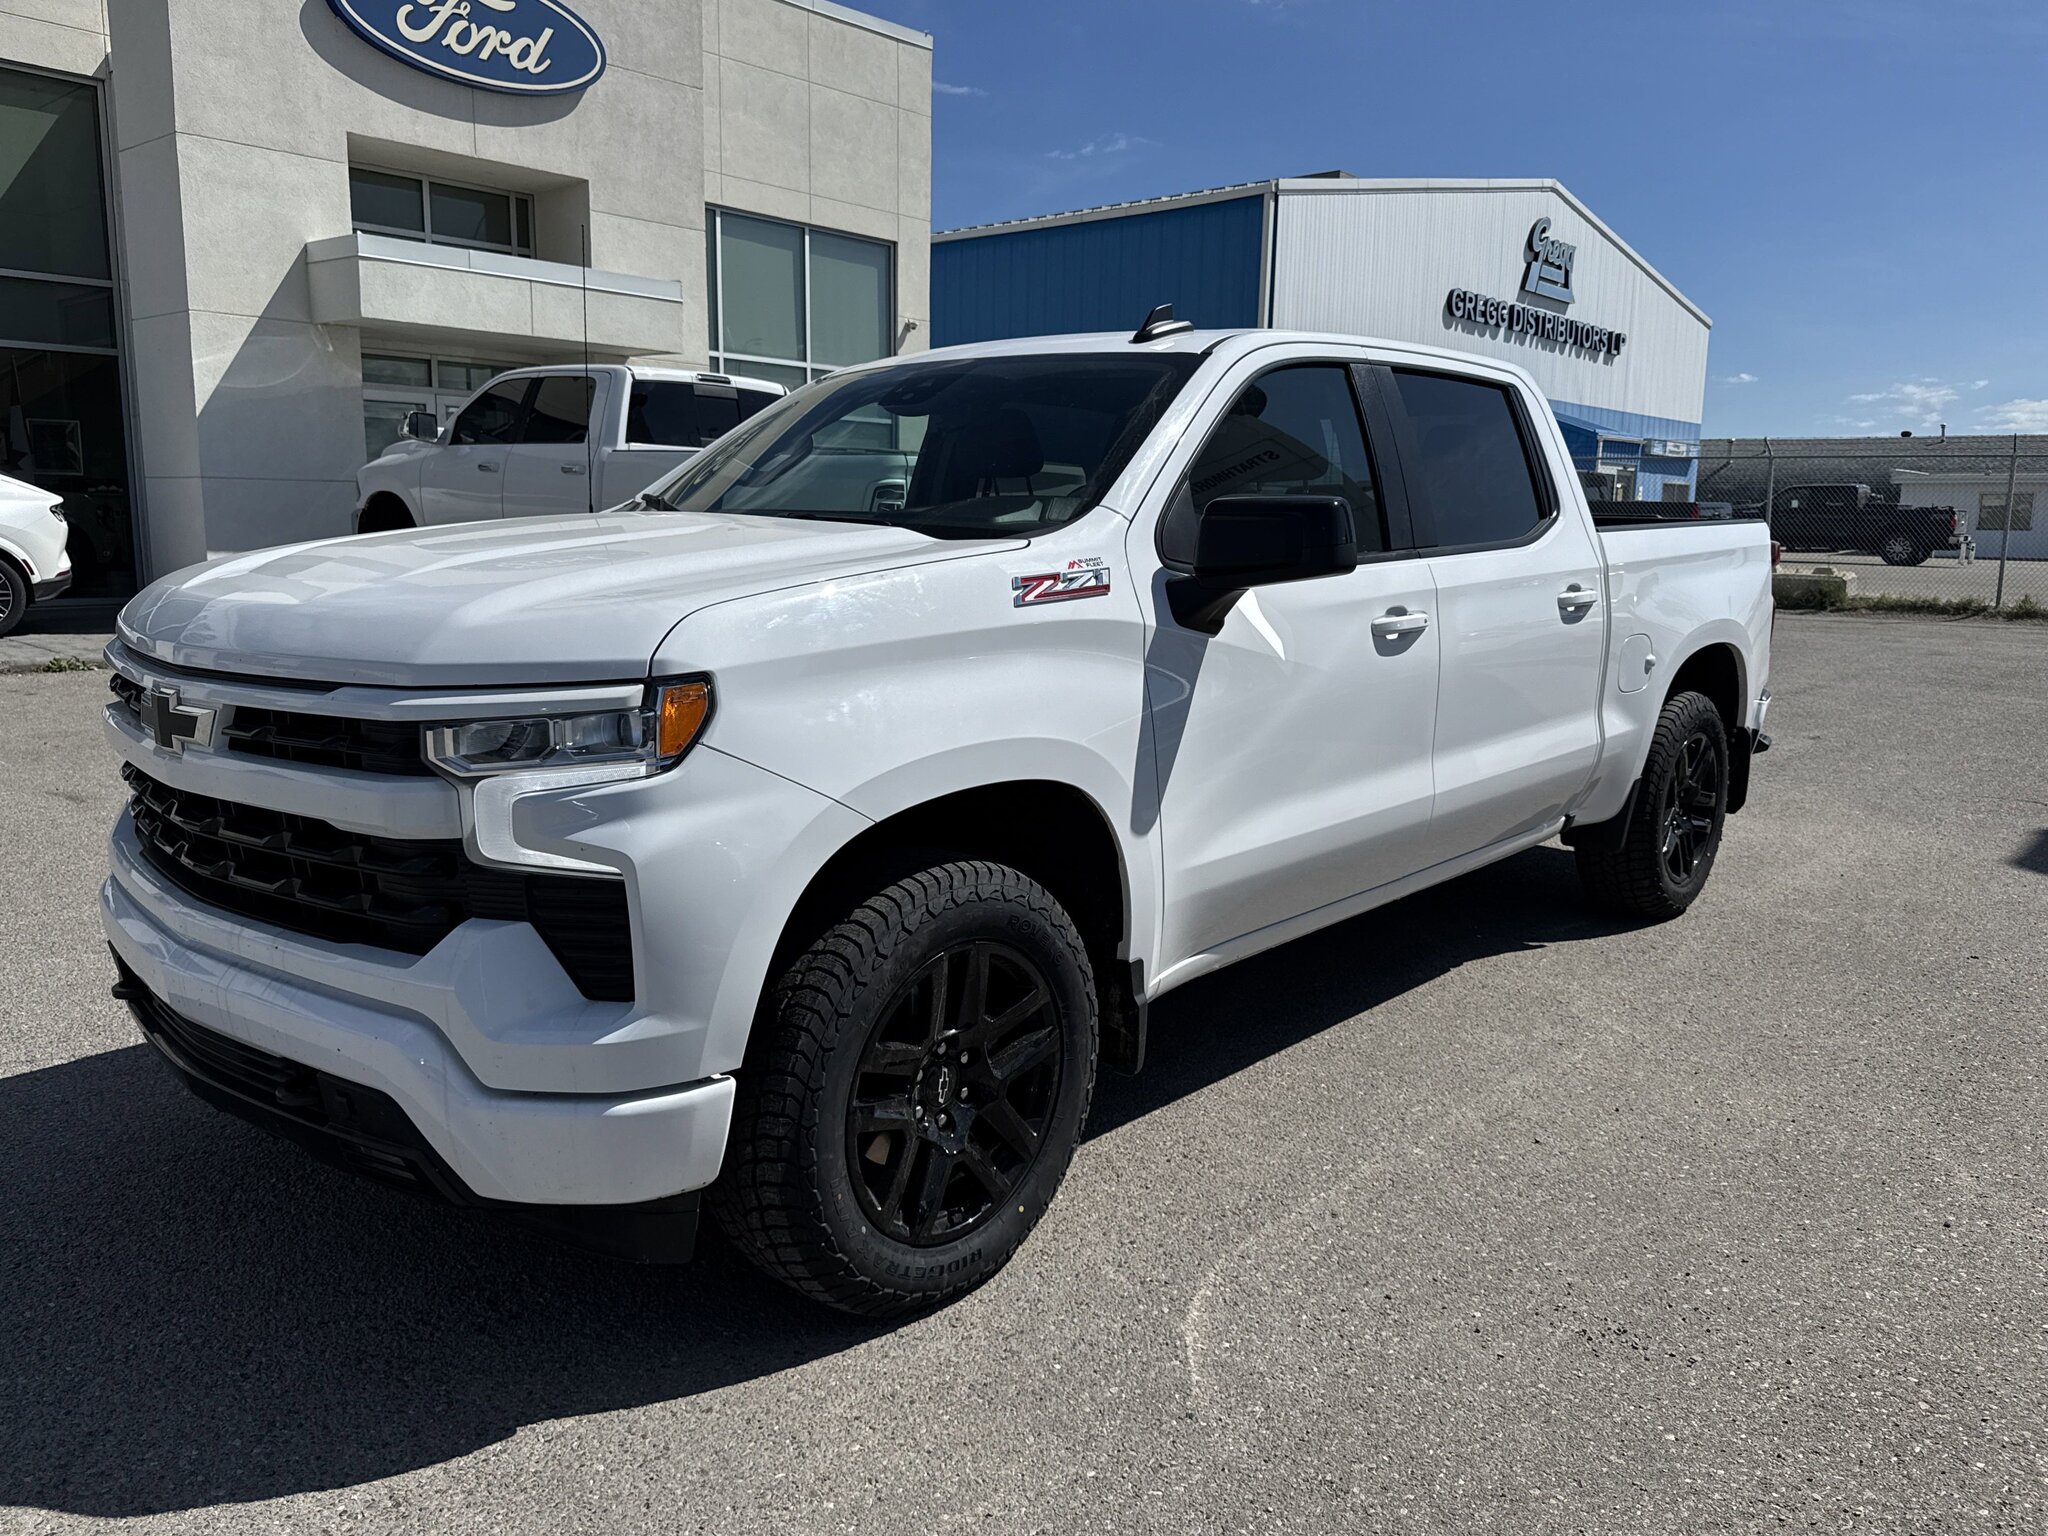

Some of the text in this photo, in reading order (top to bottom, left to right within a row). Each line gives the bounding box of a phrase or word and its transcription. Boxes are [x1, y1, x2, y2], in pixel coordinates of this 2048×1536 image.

[396, 0, 554, 74] Ford
[1531, 216, 1576, 274] Gregg
[1449, 287, 1510, 328] GREGG
[1511, 303, 1609, 352] DISTRIBUTORS
[1011, 567, 1110, 608] Z71
[1077, 556, 1102, 564] SUMMIT
